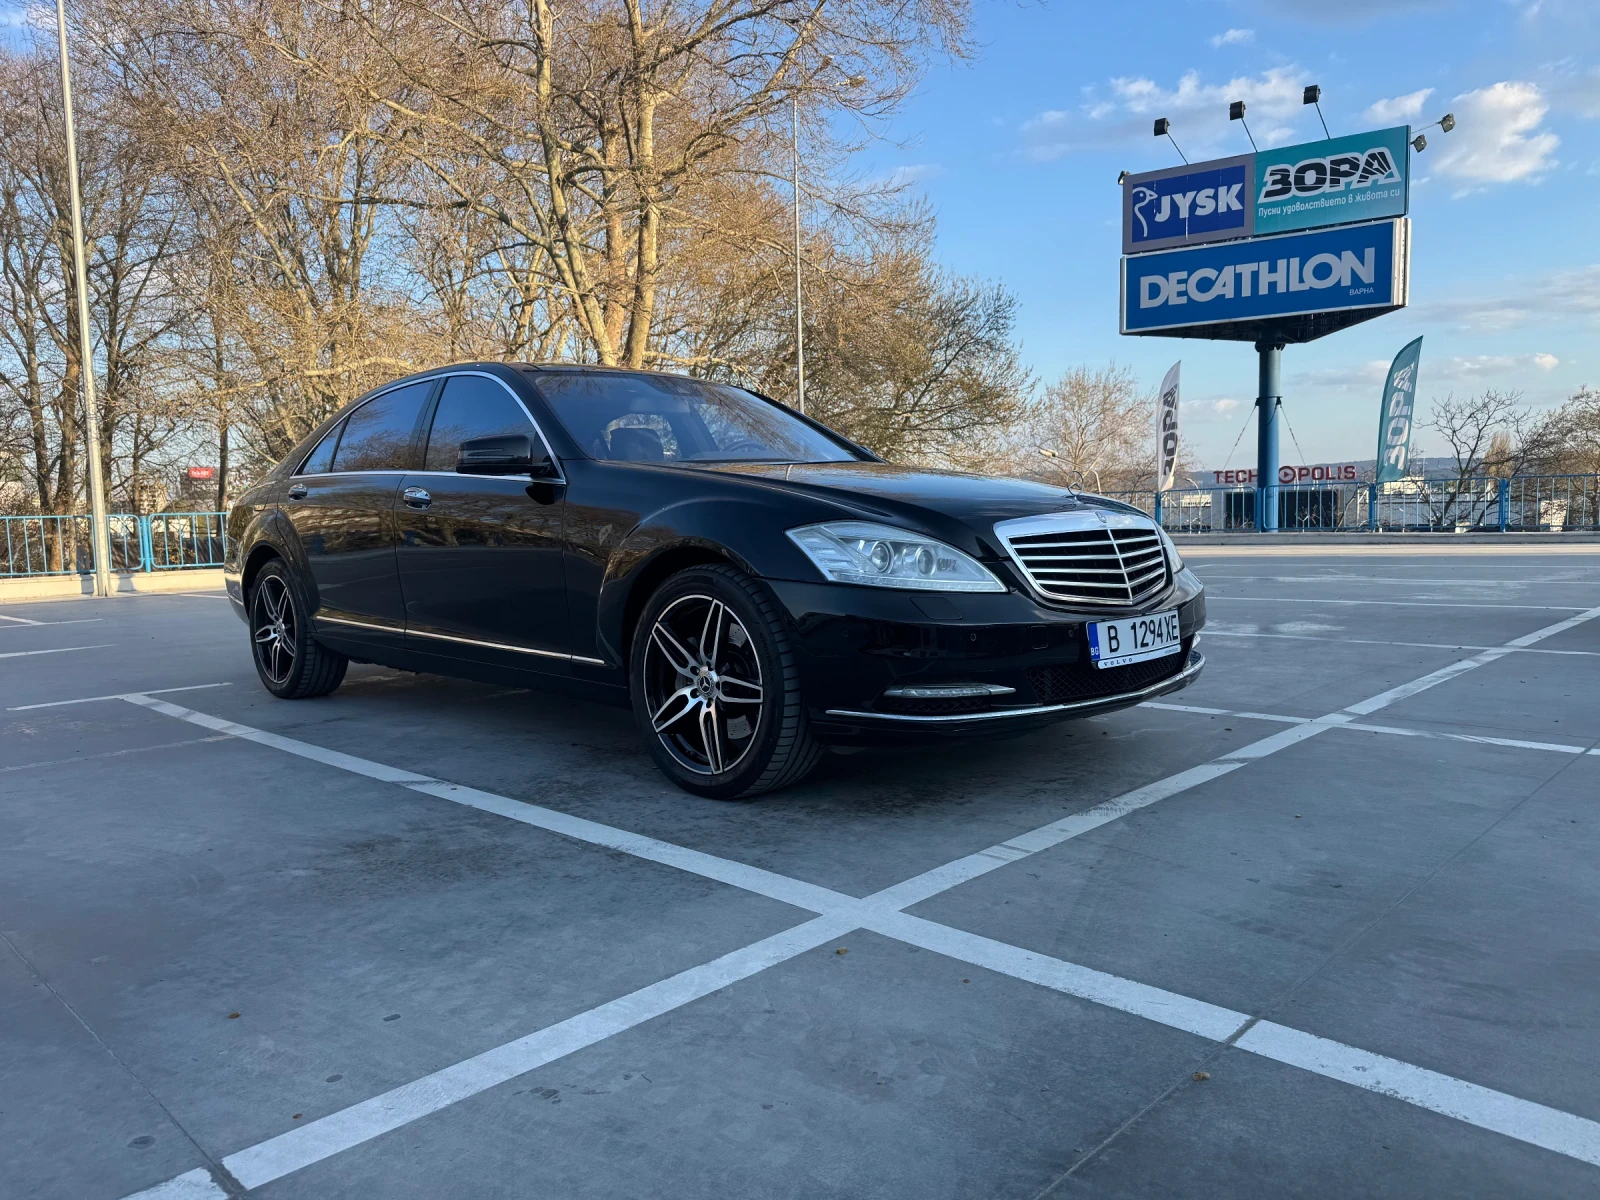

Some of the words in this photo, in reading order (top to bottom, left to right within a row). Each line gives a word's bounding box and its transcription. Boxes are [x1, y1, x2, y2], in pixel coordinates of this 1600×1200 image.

[1257, 147, 1402, 204] ЗОРА
[1154, 183, 1243, 222] JYSK
[1258, 206, 1281, 218] Пусни
[1282, 197, 1346, 216] удоволствието
[1348, 193, 1353, 204] в
[1355, 190, 1388, 203] живота
[1390, 188, 1400, 197] си
[1139, 247, 1376, 308] DECATHLON
[1349, 286, 1375, 296] ВАРНА
[1090, 647, 1100, 656] BG
[1107, 624, 1120, 653] B
[1103, 658, 1133, 667] VOLVO
